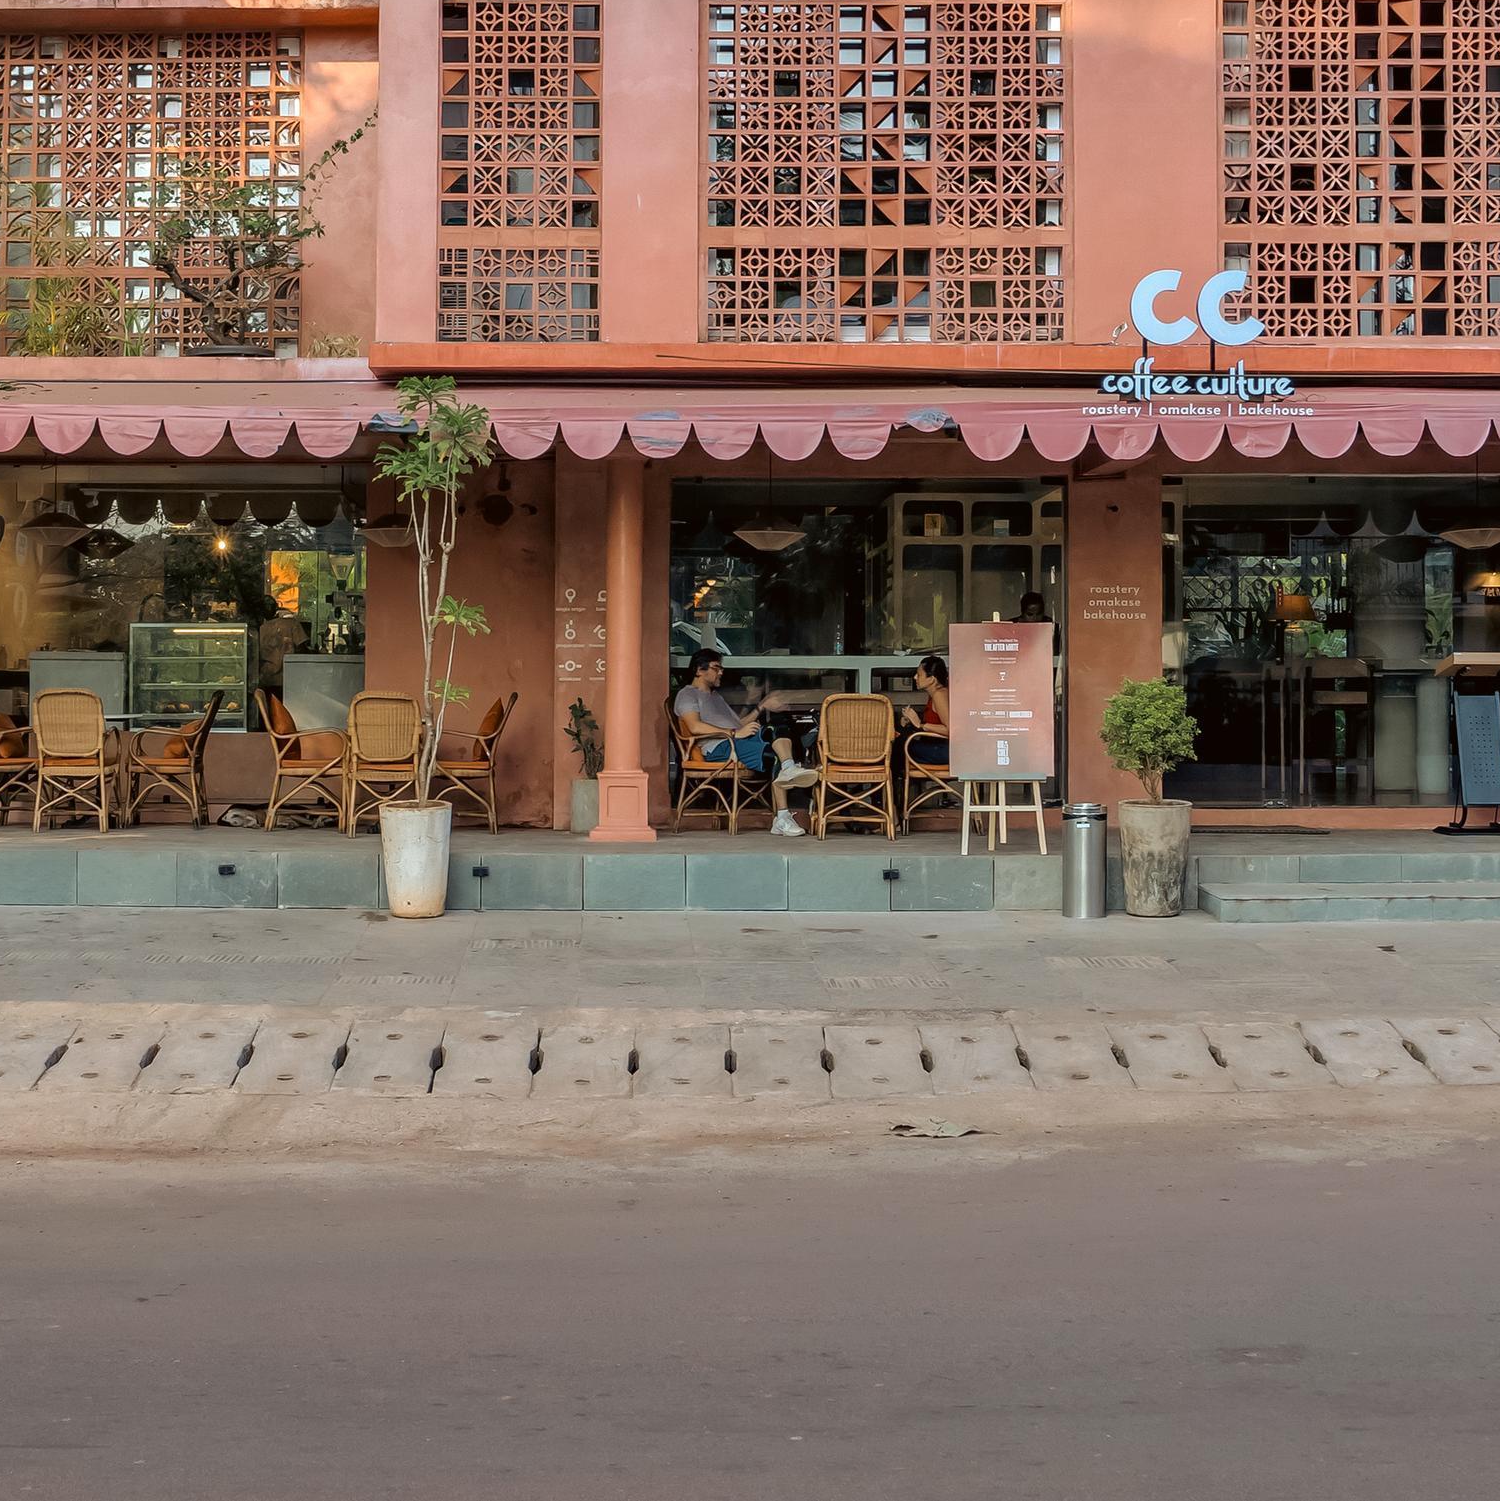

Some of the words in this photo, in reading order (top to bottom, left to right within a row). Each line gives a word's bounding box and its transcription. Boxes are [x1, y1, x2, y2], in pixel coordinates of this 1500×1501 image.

[1130, 269, 1266, 346] CC
[1102, 357, 1192, 401] coffee
[1195, 359, 1295, 401] culture
[1082, 404, 1141, 417] roastery
[1159, 404, 1221, 415] omakase
[1238, 404, 1314, 416] bakehouse
[1090, 585, 1140, 595] roastery
[1088, 597, 1141, 607] omakase
[1083, 610, 1147, 620] bakehouse
